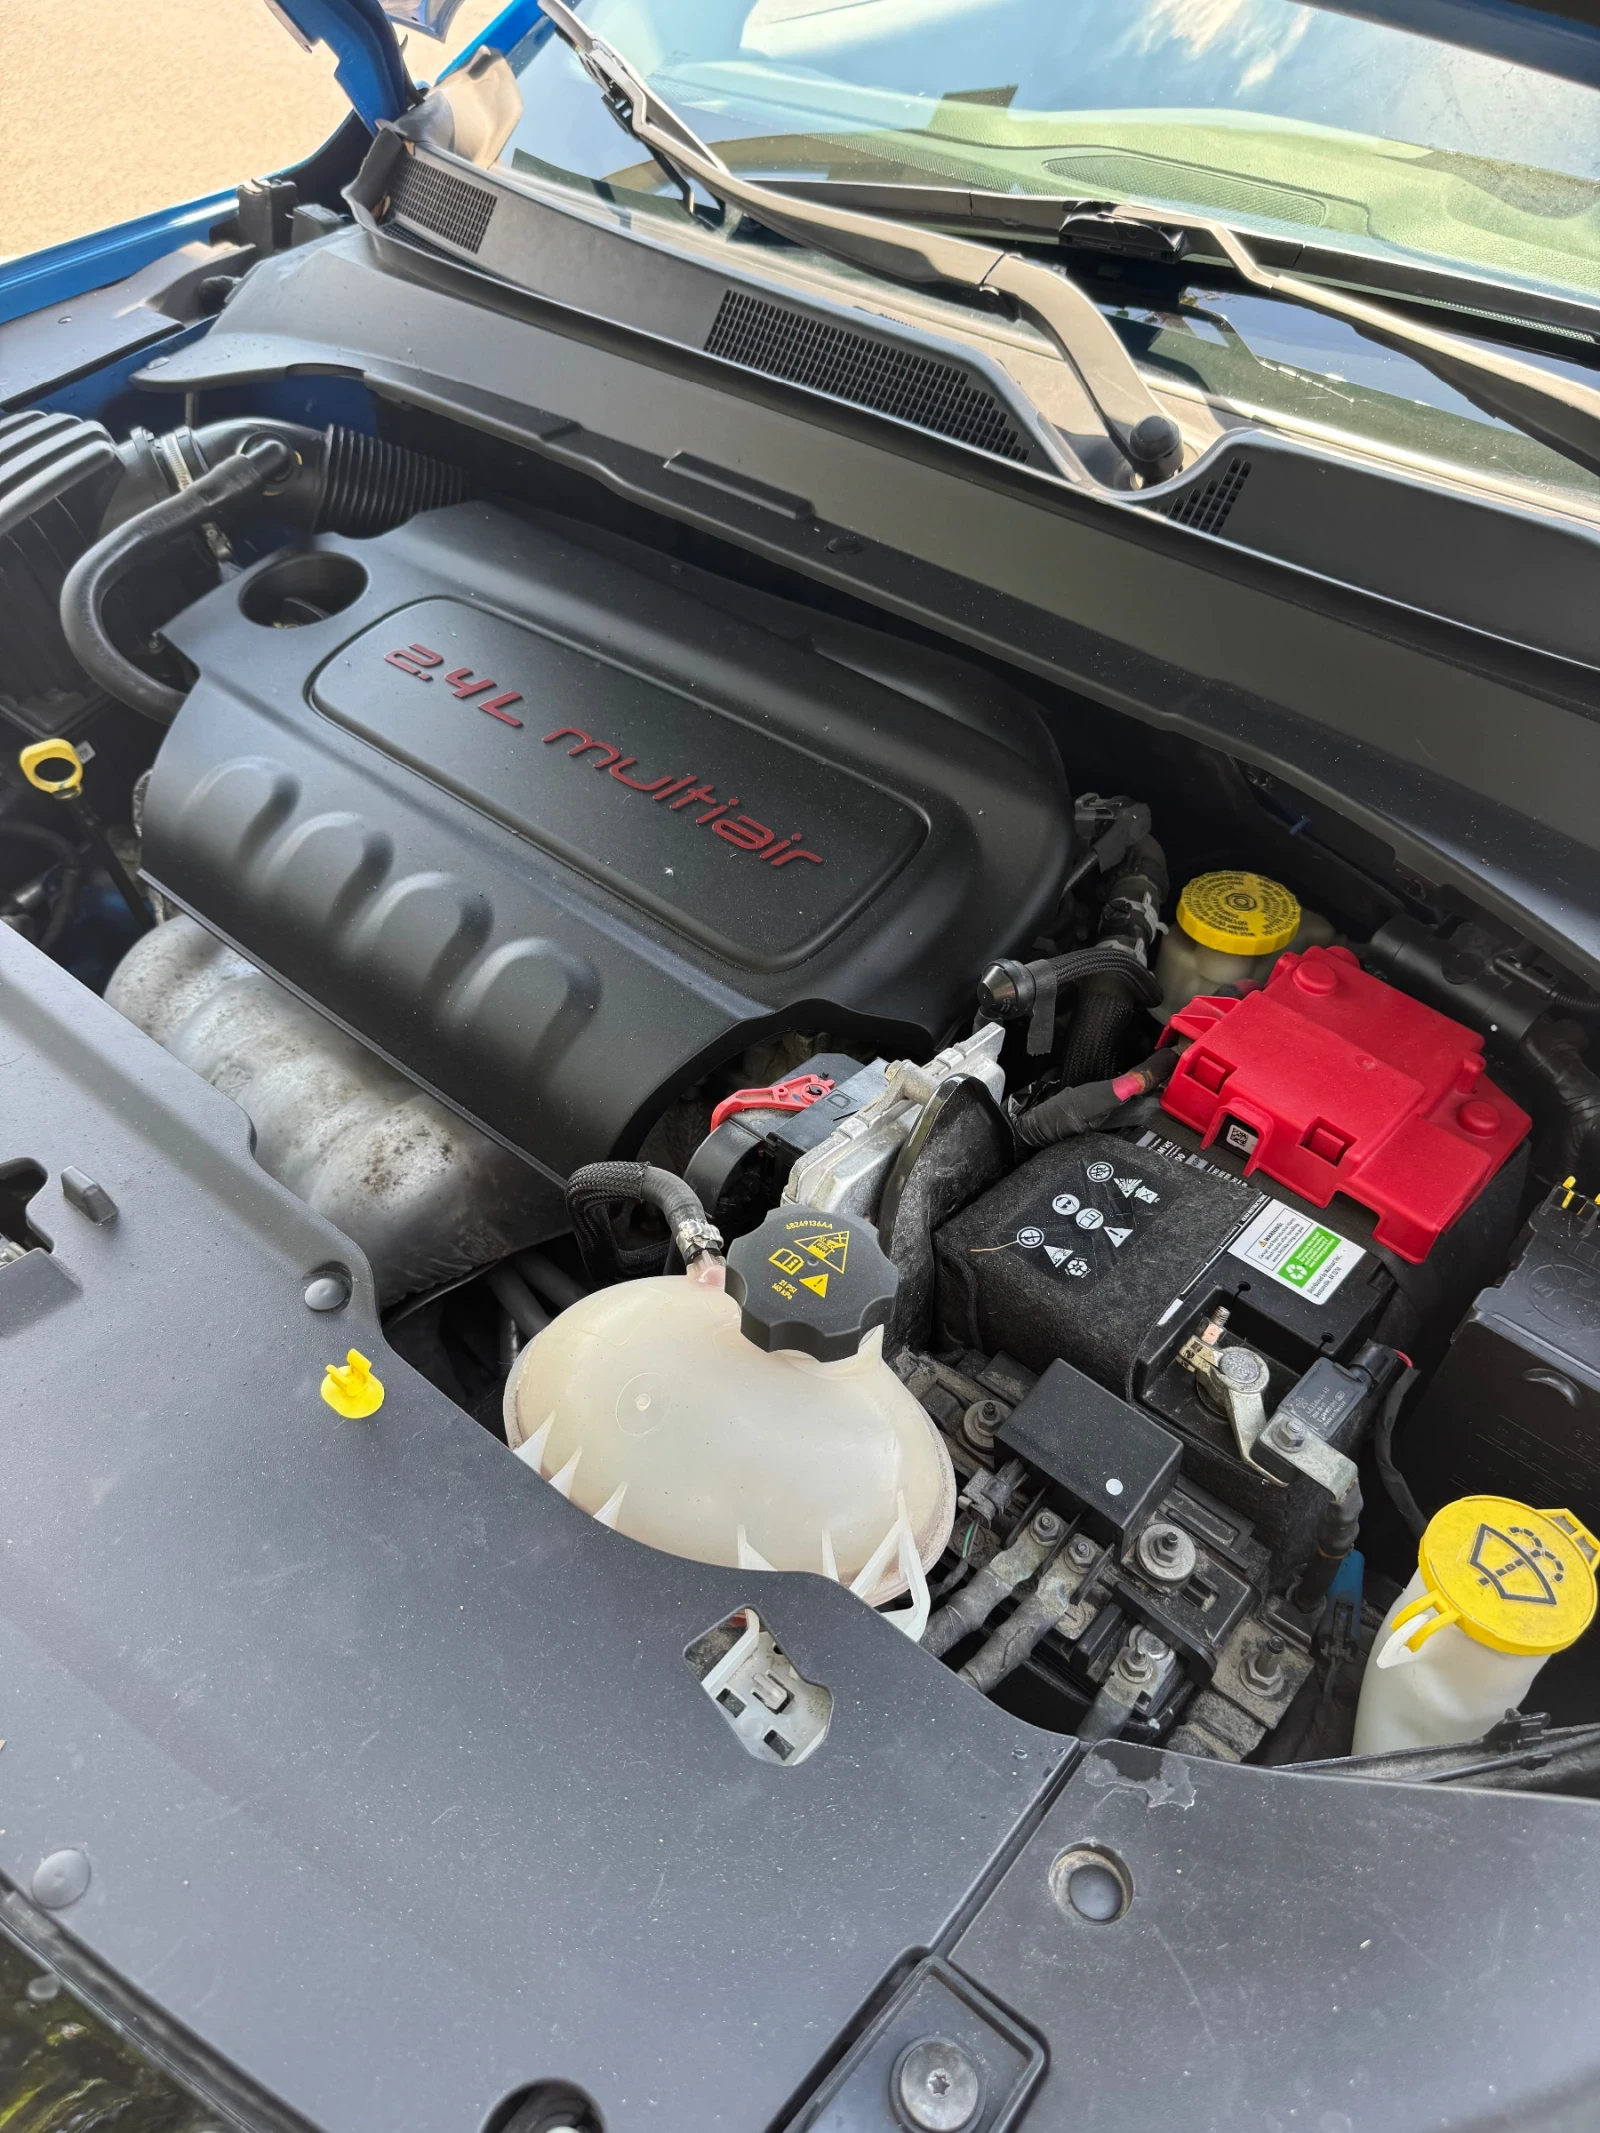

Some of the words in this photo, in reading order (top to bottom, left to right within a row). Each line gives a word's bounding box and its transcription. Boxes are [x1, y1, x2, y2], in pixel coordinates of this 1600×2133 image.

[383, 643, 523, 727] 2.4L
[542, 727, 824, 867] multiair
[785, 1220, 833, 1230] 68249136AA
